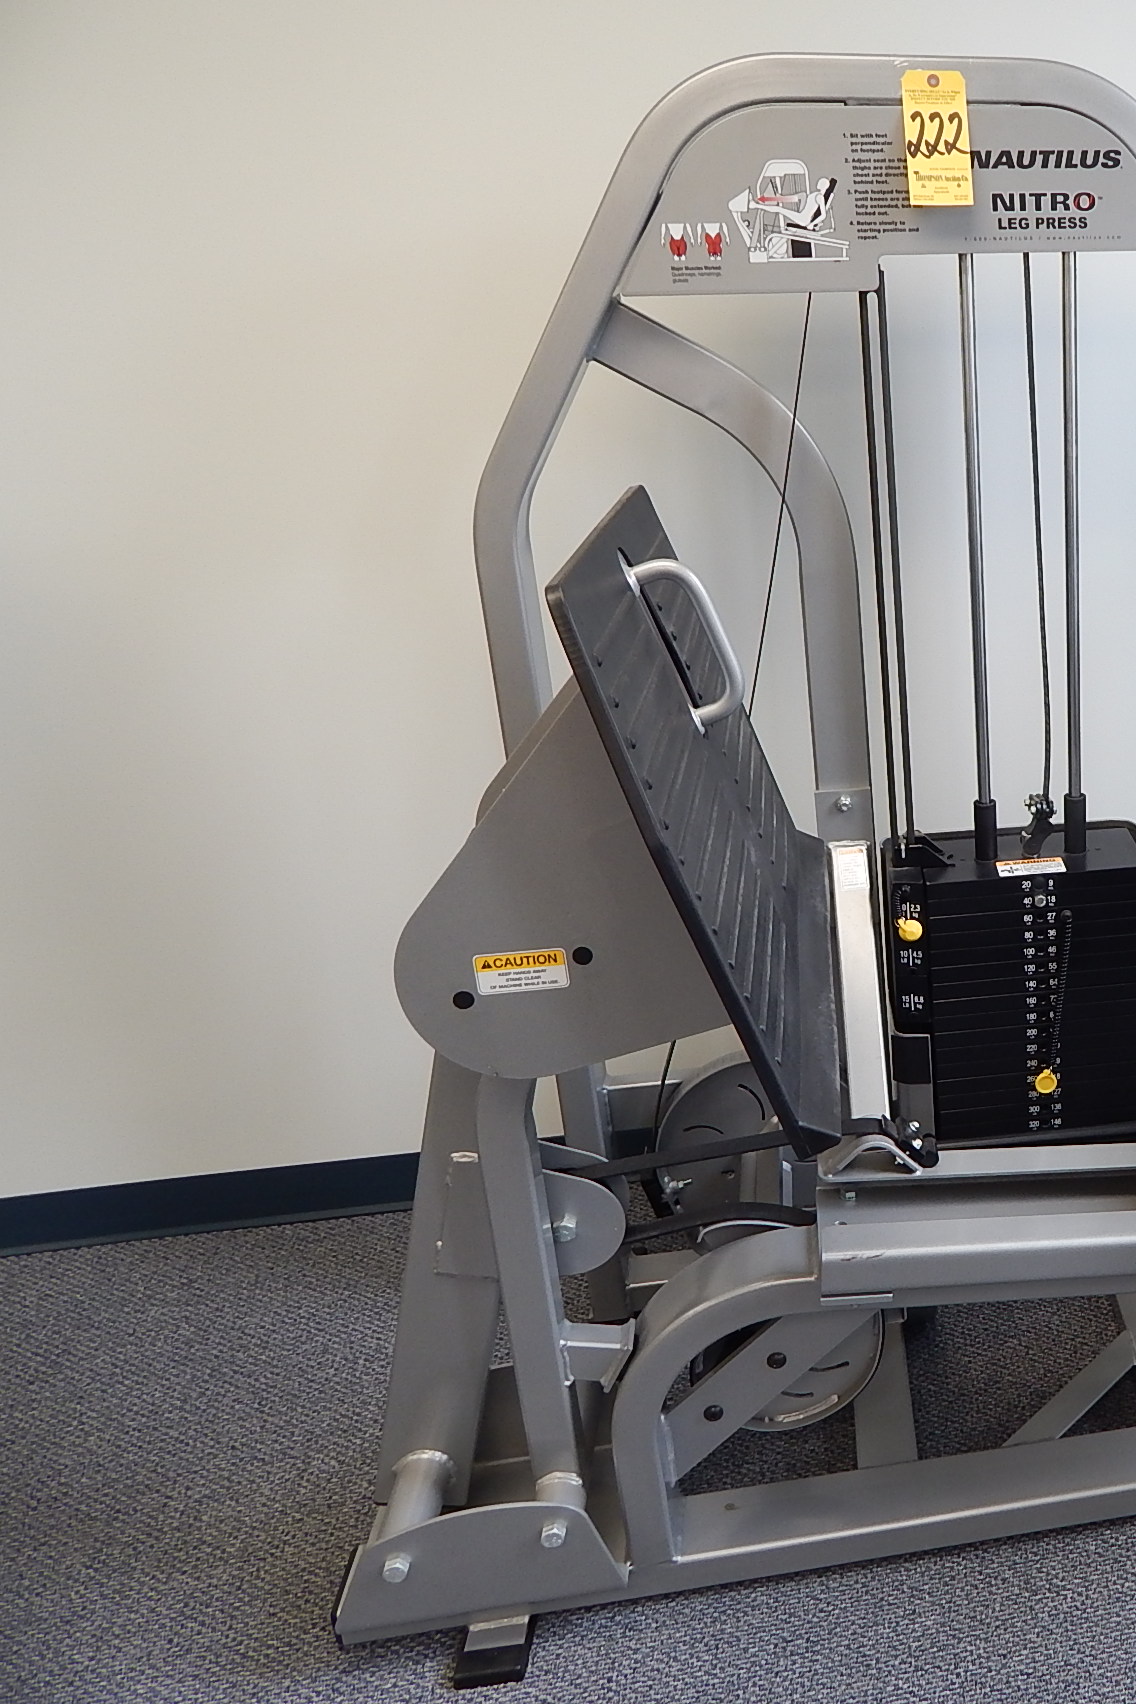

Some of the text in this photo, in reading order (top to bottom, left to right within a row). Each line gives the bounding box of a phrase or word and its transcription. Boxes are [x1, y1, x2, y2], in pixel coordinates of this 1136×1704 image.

[905, 110, 970, 159] 222
[970, 149, 1122, 170] NAUTILUS
[991, 192, 1096, 213] NITRO
[998, 216, 1088, 230] LEG PRESS
[1022, 879, 1054, 889] 20 9
[1047, 895, 1056, 903] 18
[1023, 912, 1056, 922] 60 27
[1024, 929, 1057, 939] 80 36
[1023, 947, 1035, 956] 100
[493, 953, 558, 969] CAUTION
[1024, 964, 1036, 972] 120
[1025, 980, 1037, 988] 140
[1026, 1028, 1038, 1036] 200
[1028, 1105, 1040, 1113] 300
